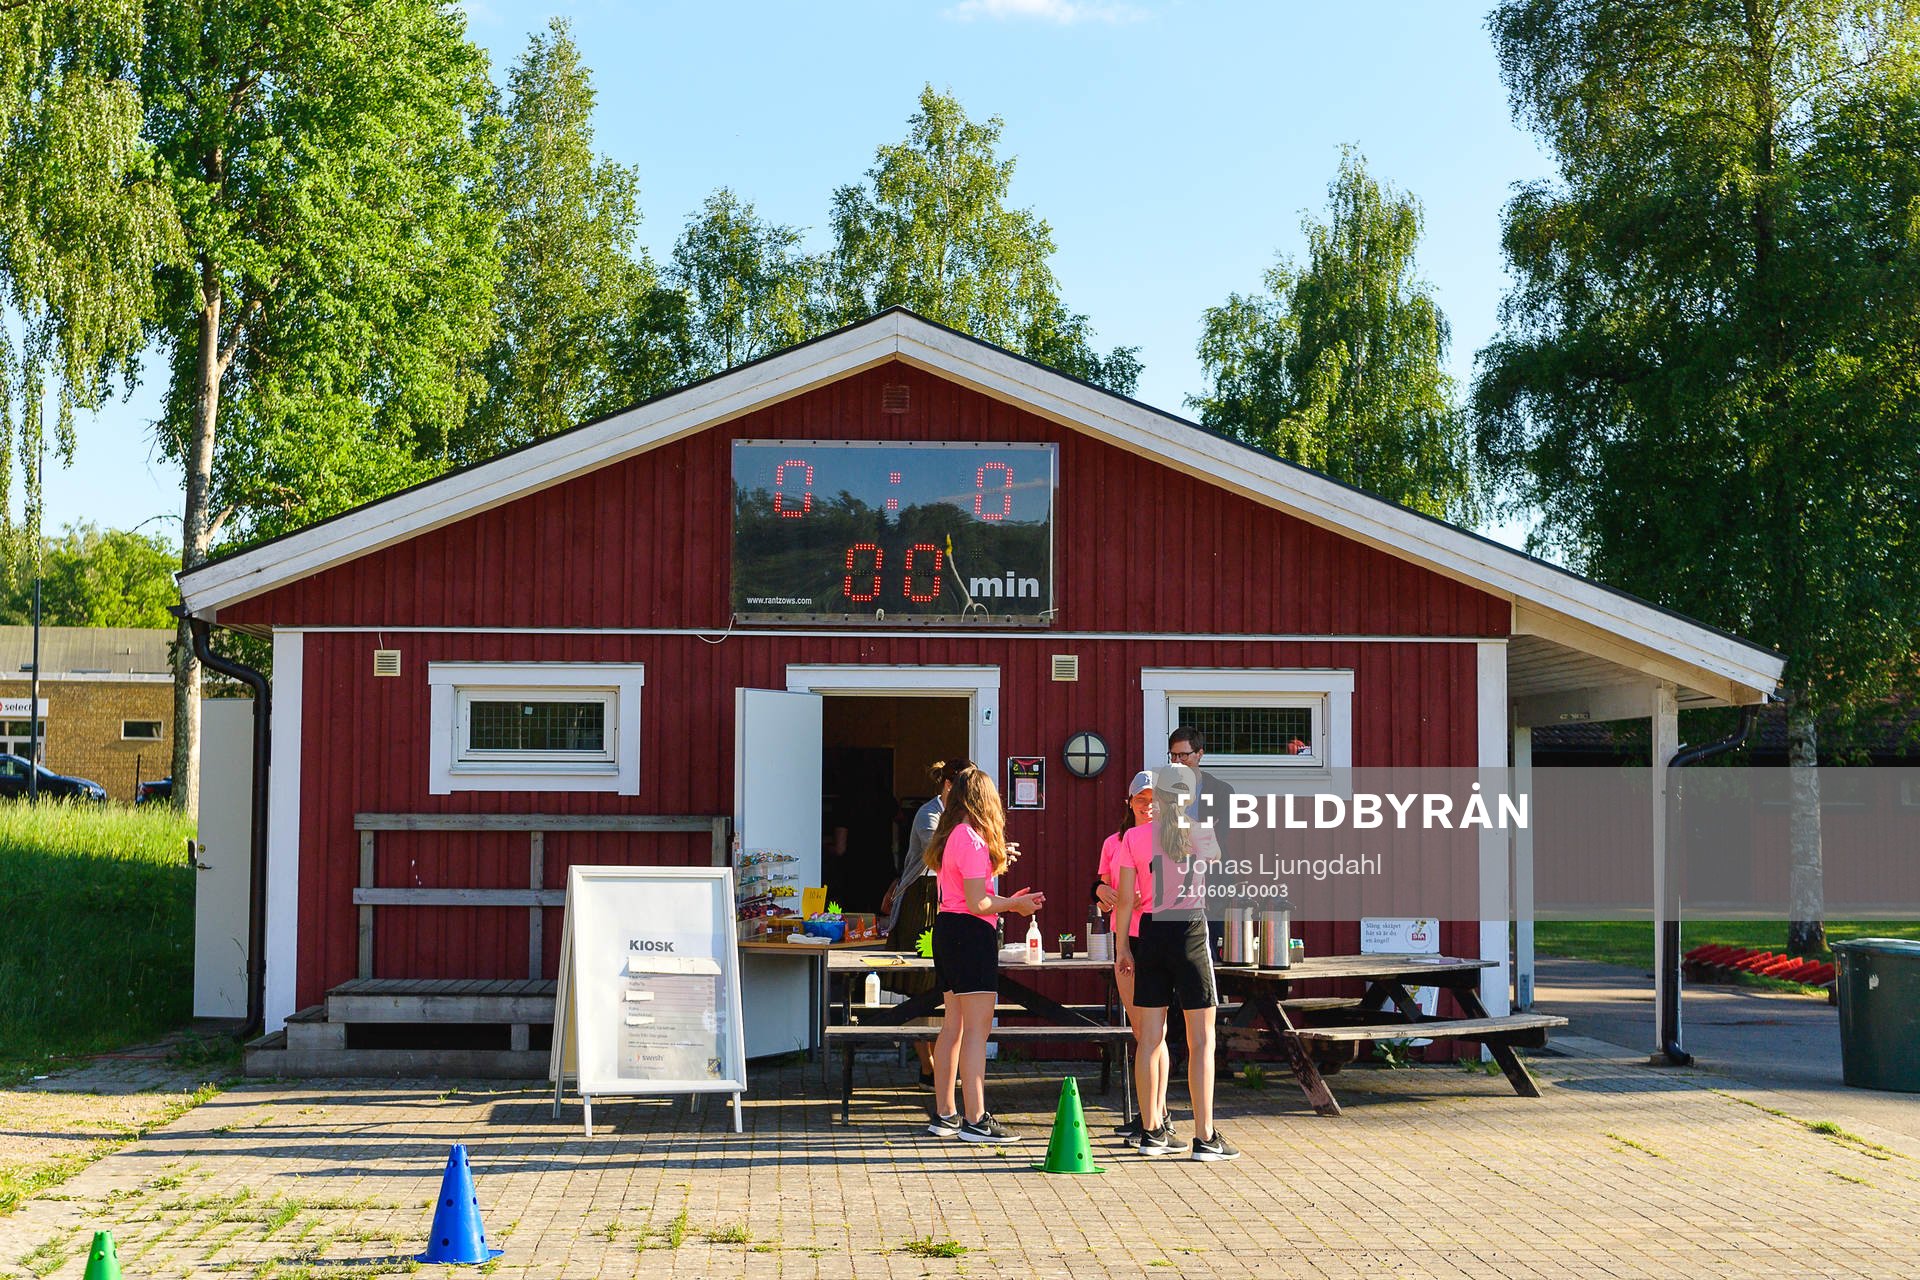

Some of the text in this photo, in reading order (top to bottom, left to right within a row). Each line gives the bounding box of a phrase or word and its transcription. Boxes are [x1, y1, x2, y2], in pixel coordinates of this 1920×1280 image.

[774, 460, 813, 518] 0
[974, 462, 1014, 521] 0
[844, 544, 1040, 602] 00 min
[746, 596, 812, 606] www.rantzows.com
[629, 939, 674, 952] KIOSK
